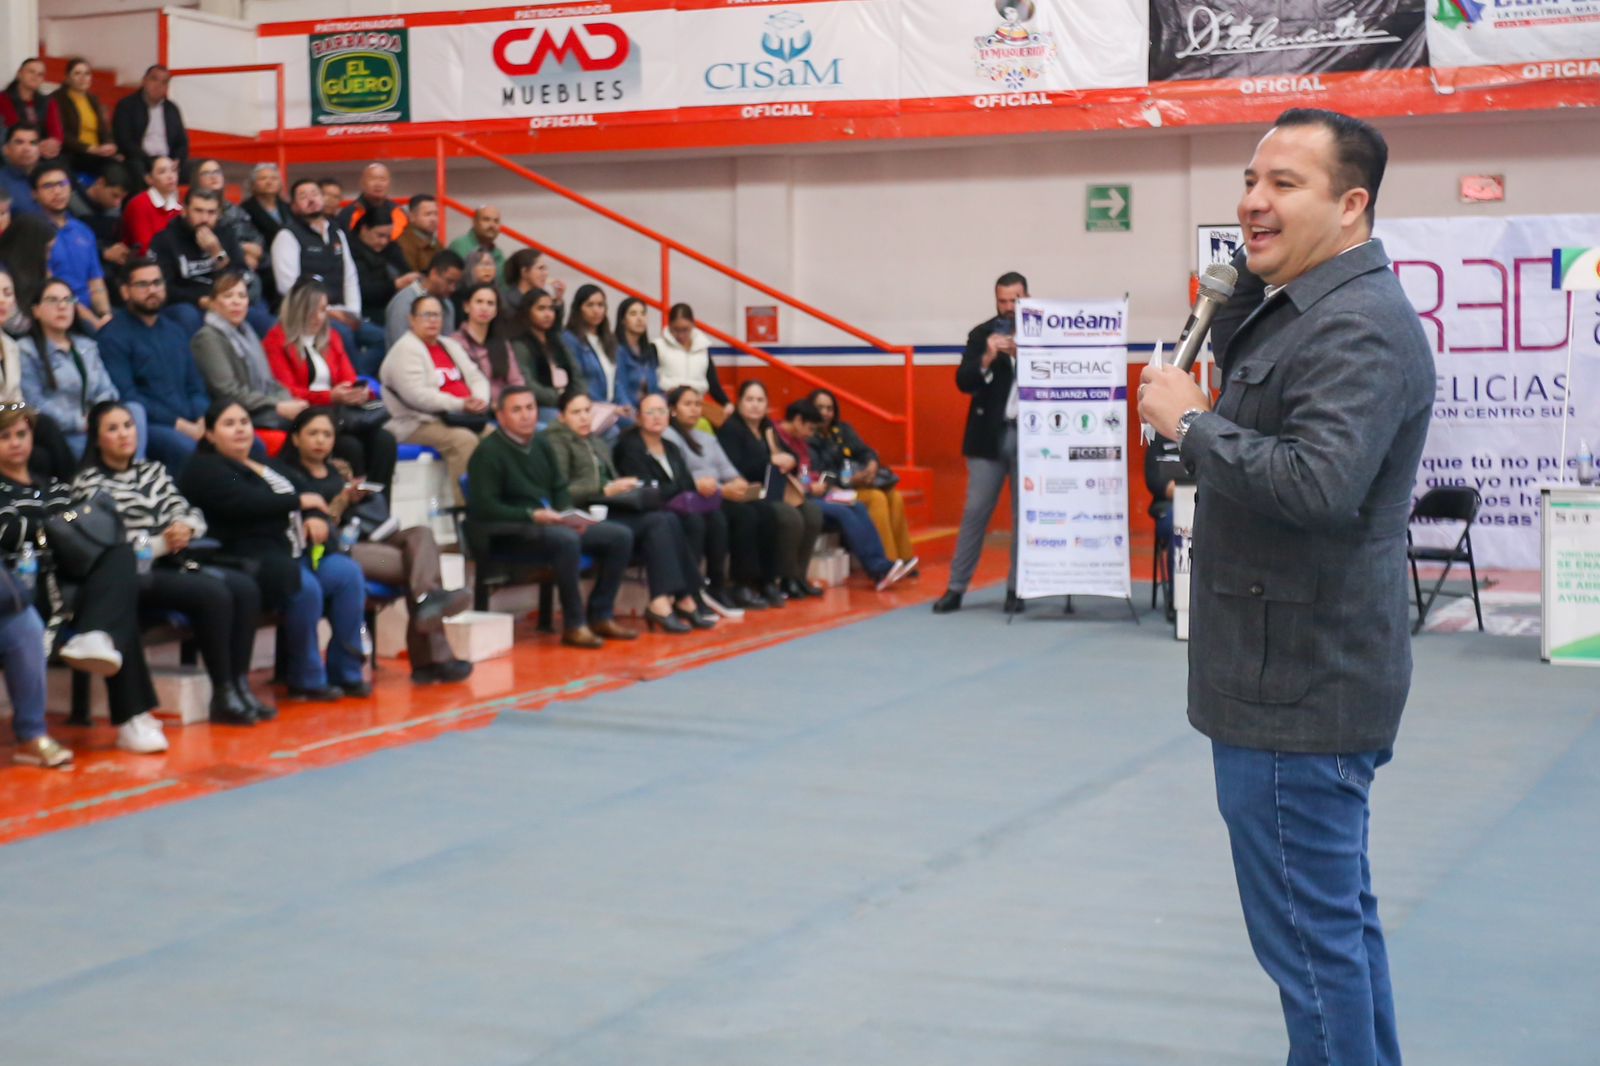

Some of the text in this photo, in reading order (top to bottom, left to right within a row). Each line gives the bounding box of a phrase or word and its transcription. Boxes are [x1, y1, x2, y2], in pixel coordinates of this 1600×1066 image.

[515, 5, 611, 20] PATROCINADOR
[311, 32, 402, 58] BARBACOA
[346, 60, 370, 76] EL
[704, 58, 844, 90] CISaM
[502, 80, 624, 106] MUEBLES
[1239, 77, 1327, 94] OFICIAL
[974, 92, 1053, 108] OFICIAL
[741, 103, 813, 119] OFICIAL
[530, 114, 597, 129] OFICIAL
[1047, 310, 1122, 330] onéami
[1053, 361, 1112, 374] FECHAC
[1464, 407, 1535, 418] CENTRO
[1422, 457, 1463, 472] que
[1501, 456, 1529, 469] no
